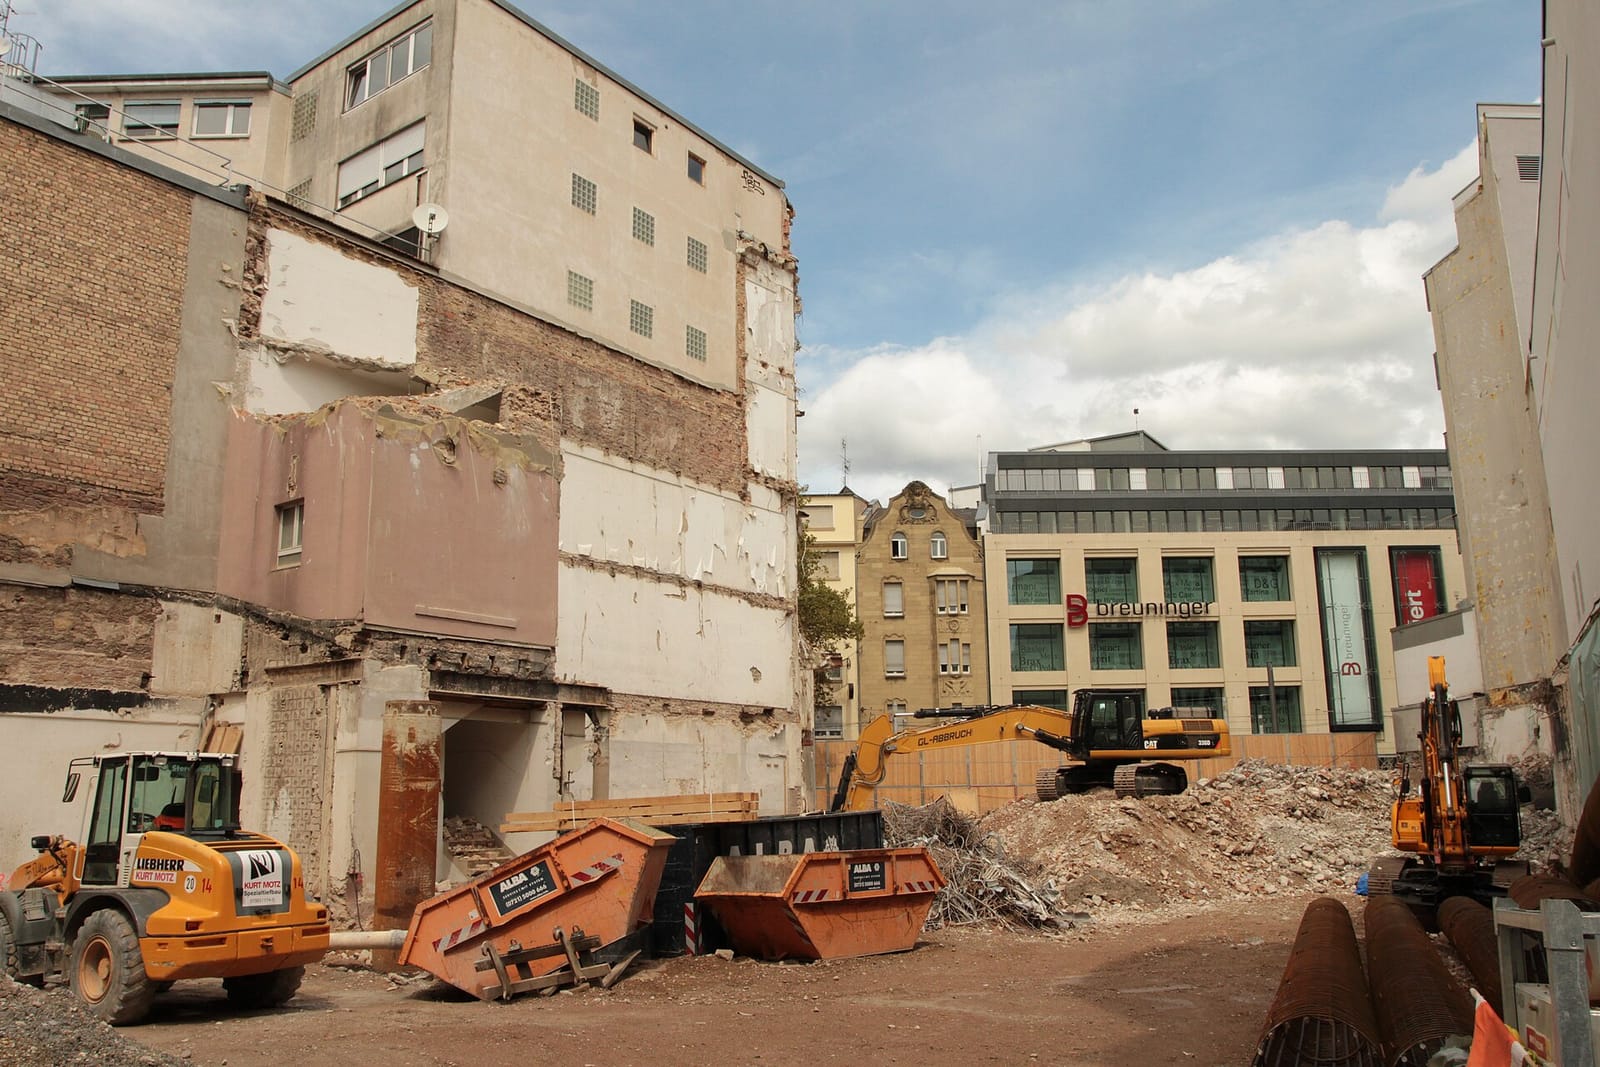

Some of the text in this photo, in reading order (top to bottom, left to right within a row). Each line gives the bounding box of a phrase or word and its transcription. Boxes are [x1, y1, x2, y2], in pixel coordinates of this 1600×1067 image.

[1096, 599, 1213, 619] breuninger
[1407, 589, 1425, 624] ert
[1341, 604, 1354, 660] breuninger
[917, 729, 973, 746] GL-ABBRUCH
[1143, 740, 1158, 749] CAT
[136, 858, 185, 872] LIEBHERR
[853, 863, 873, 874] ALBA
[135, 871, 175, 883] KURT MOTZ
[186, 877, 195, 890] 20
[293, 877, 304, 889] 14
[500, 873, 528, 893] ALBA
[201, 877, 213, 894] 14
[243, 880, 281, 889] KURT MOTZ
